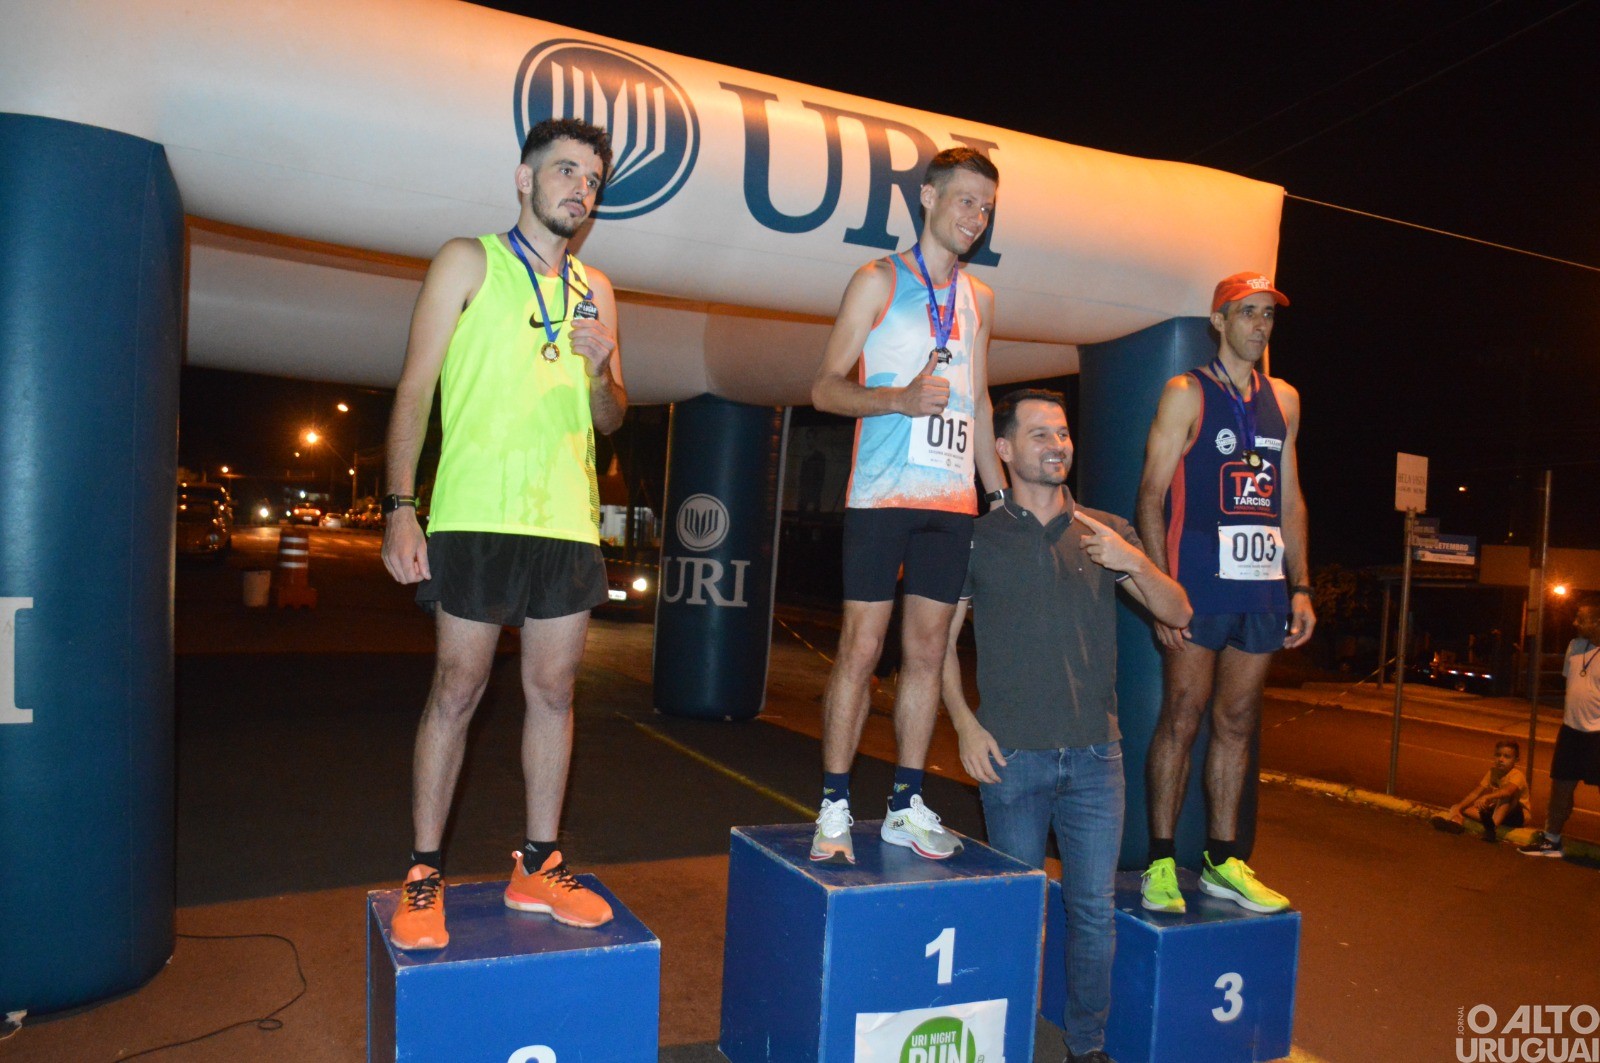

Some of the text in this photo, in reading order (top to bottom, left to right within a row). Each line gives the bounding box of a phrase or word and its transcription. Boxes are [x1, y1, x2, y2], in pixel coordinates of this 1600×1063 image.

[927, 414, 968, 453] 015
[1230, 472, 1273, 498] TAG
[1233, 497, 1271, 507] TARCISO
[1232, 532, 1277, 562] 003
[662, 556, 751, 608] URI
[925, 927, 955, 984] 1
[1211, 972, 1243, 1021] 3
[911, 1031, 957, 1047] URI NIGHT
